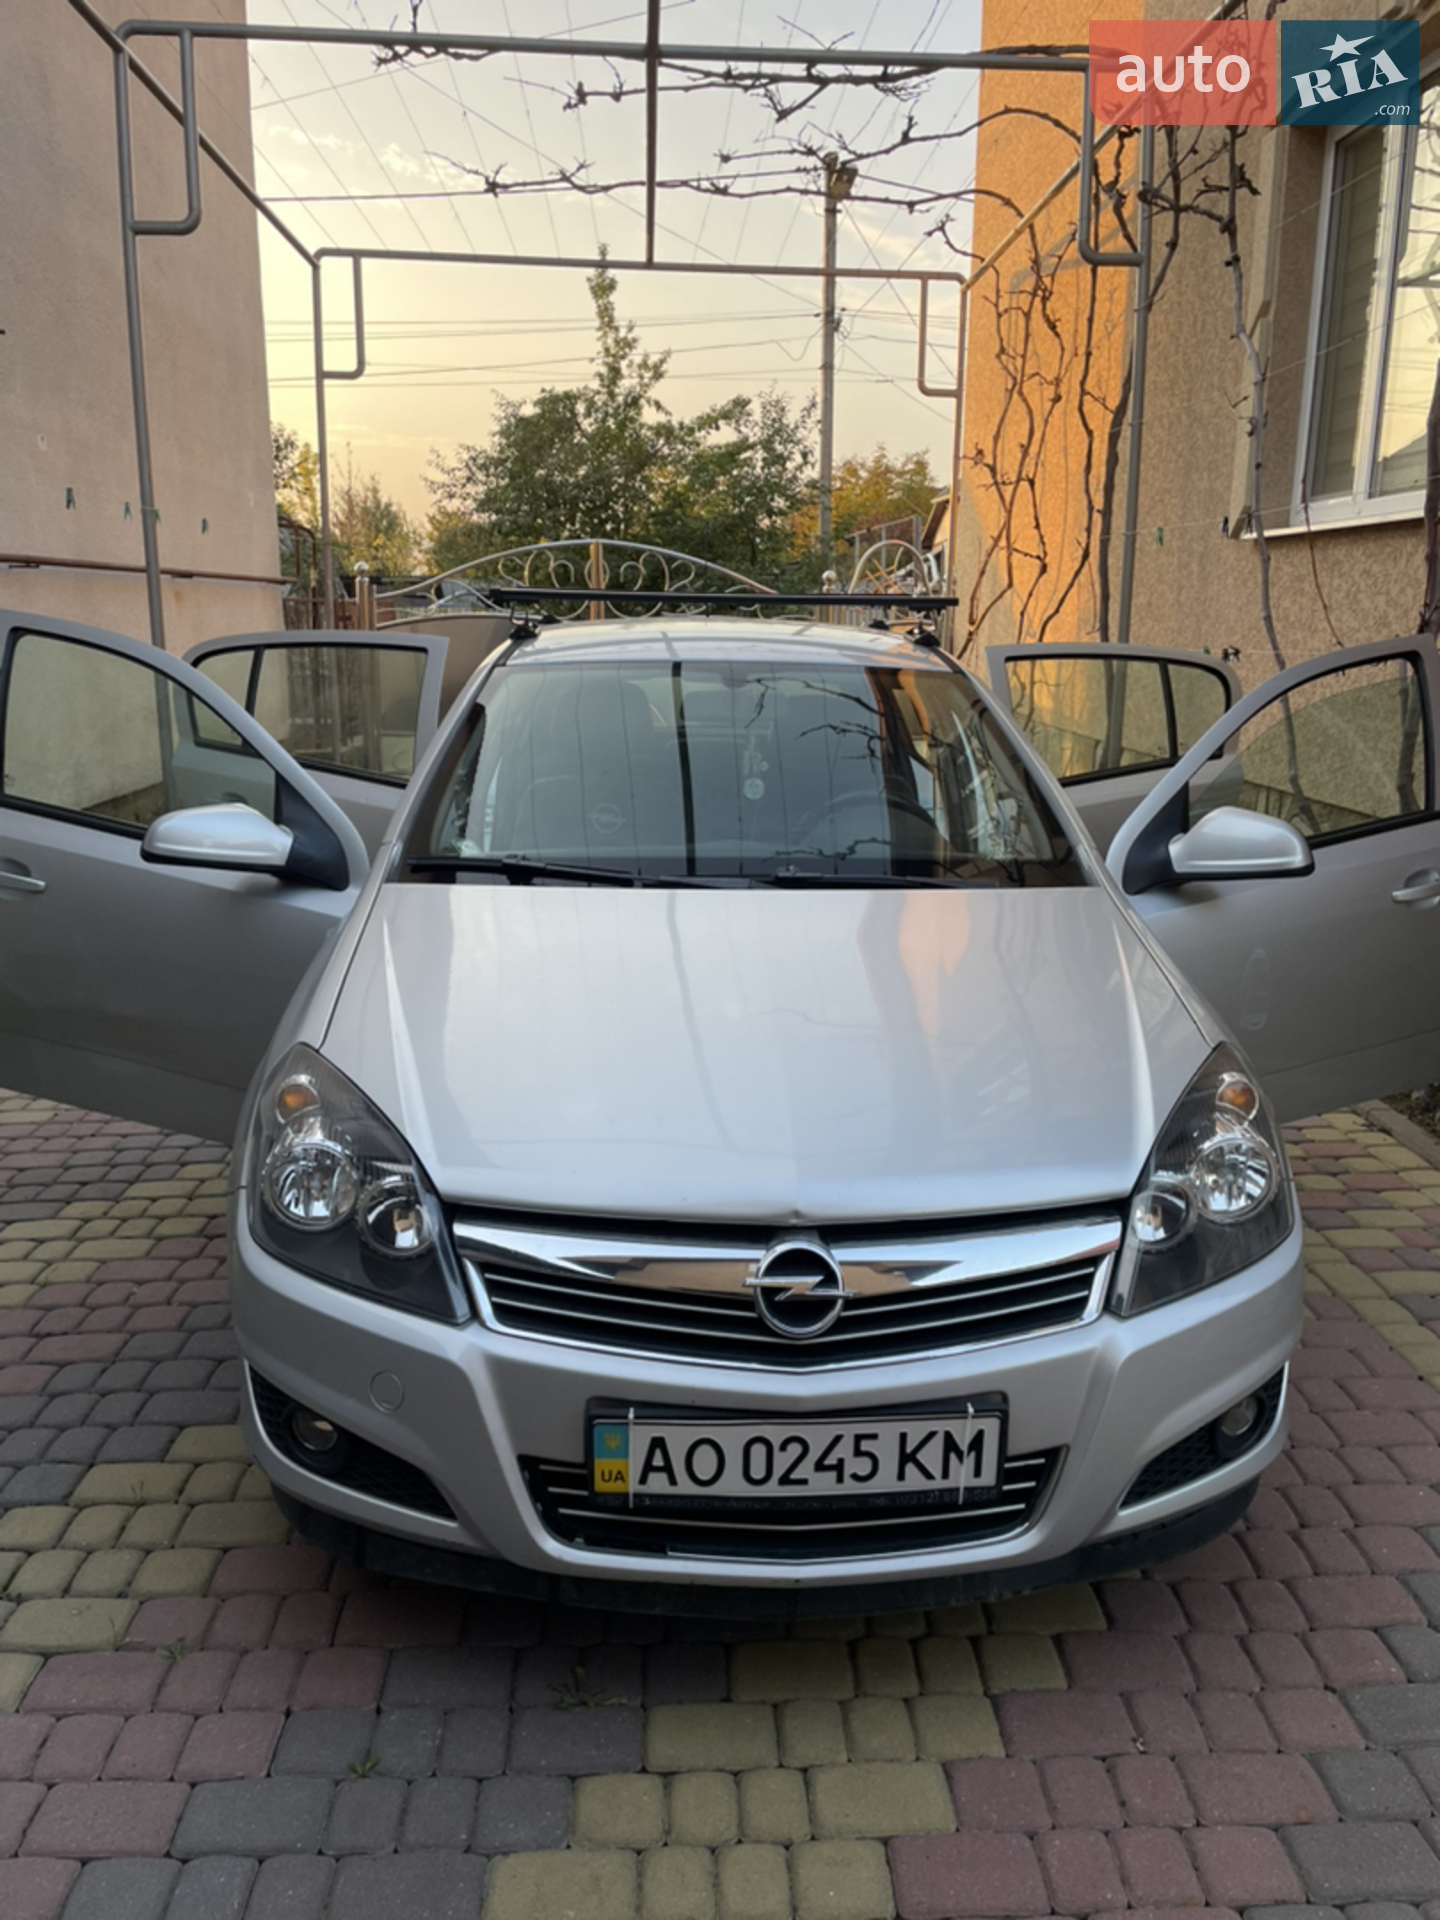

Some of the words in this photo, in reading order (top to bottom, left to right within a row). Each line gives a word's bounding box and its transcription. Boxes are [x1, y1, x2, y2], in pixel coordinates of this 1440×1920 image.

[600, 1469, 626, 1483] UA
[638, 1435, 726, 1487] AO
[742, 1433, 879, 1486] 0245
[897, 1429, 985, 1482] KM
